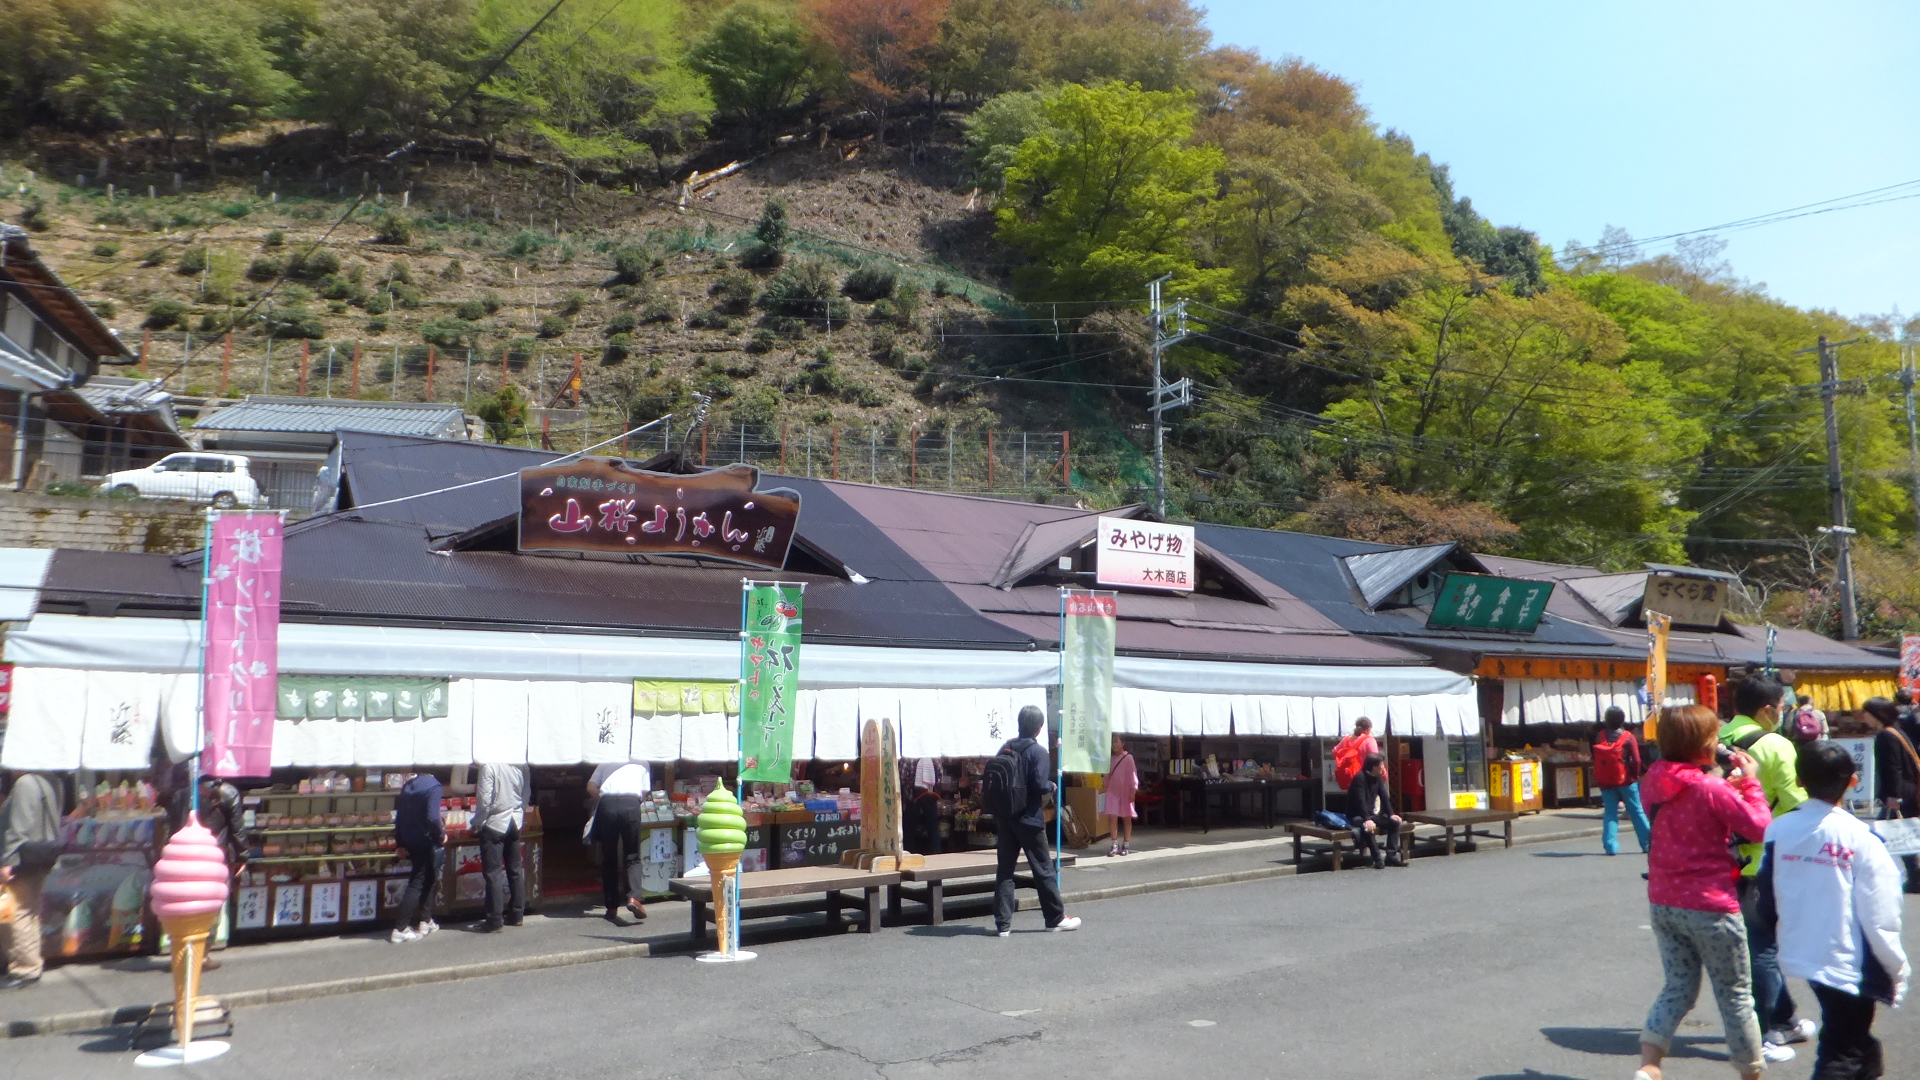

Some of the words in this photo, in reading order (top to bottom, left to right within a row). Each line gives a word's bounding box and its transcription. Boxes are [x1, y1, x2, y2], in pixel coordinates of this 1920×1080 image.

[556, 474, 636, 495] 自家製手づくり
[548, 498, 749, 543] 山桜ようかん
[1110, 528, 1183, 554] みやげ物
[1142, 567, 1187, 584] 大木商店
[1490, 586, 1512, 623] 食堂
[1518, 588, 1540, 625] コーヒー
[597, 707, 615, 744] 近藤
